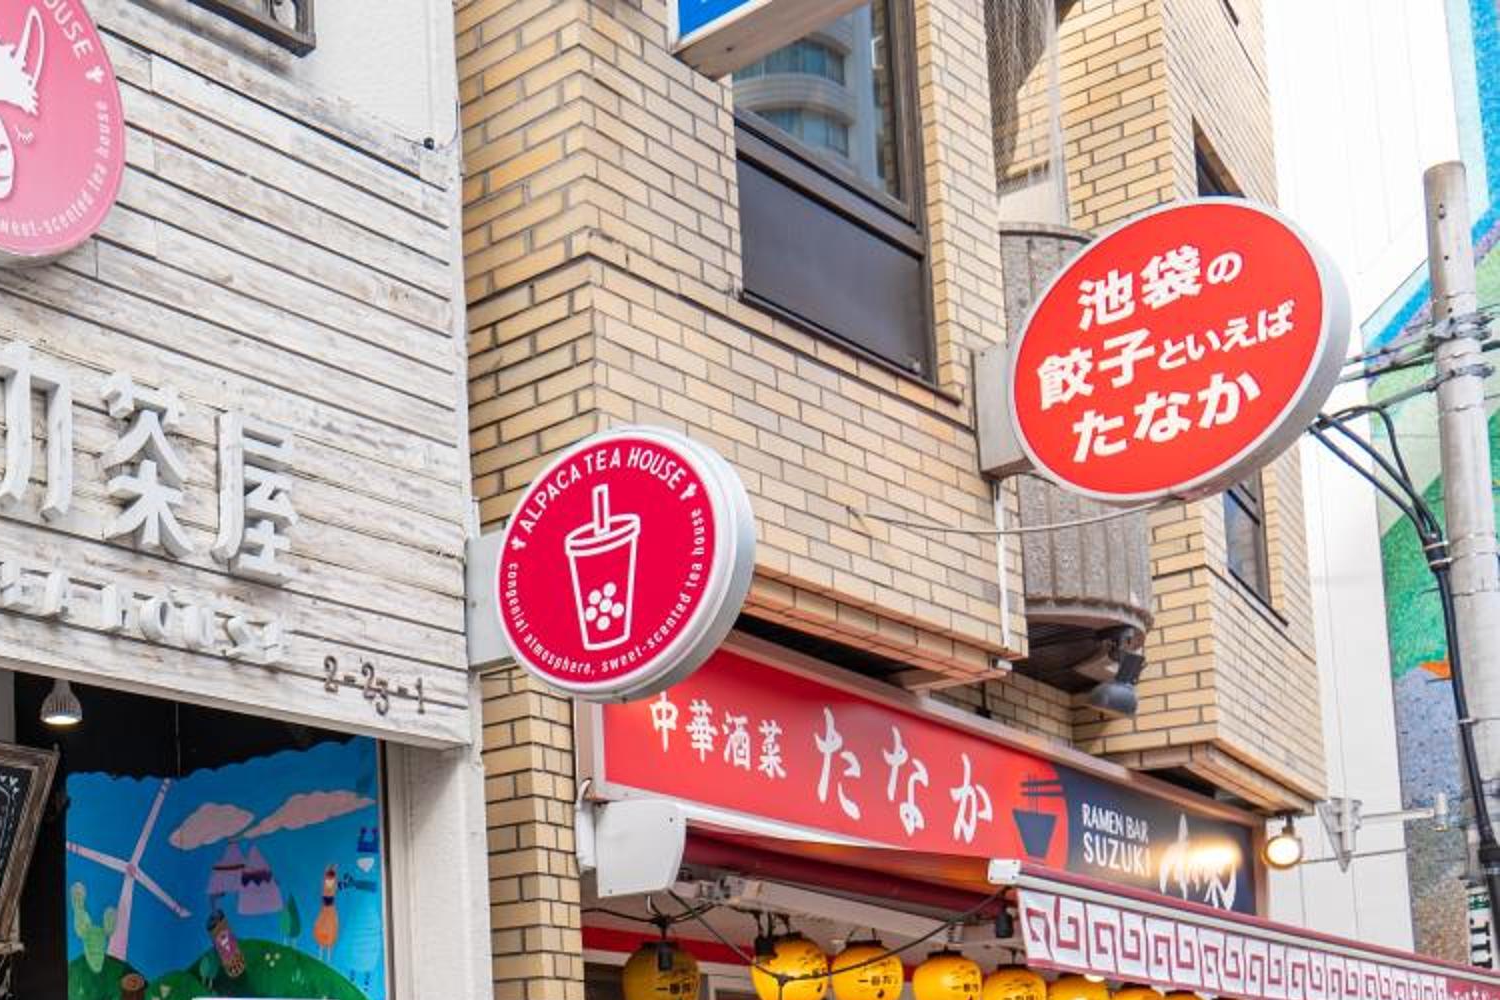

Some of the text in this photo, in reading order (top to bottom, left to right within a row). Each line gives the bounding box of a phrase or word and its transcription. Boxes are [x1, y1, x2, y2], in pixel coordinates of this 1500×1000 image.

[1077, 244, 1244, 332] 池袋の
[1036, 298, 1297, 412] 餃子といえば
[1071, 371, 1263, 463] たなか
[521, 446, 687, 536] ALPACA TEA HOUSE
[691, 508, 706, 558] house
[504, 562, 531, 634] congenial
[686, 563, 703, 589] tea
[99, 581, 291, 668] HOUSE
[649, 690, 994, 844] 中華酒菜 たなか
[1082, 803, 1150, 845] RAMEN BAR
[1083, 831, 1152, 879] SUZUKI
